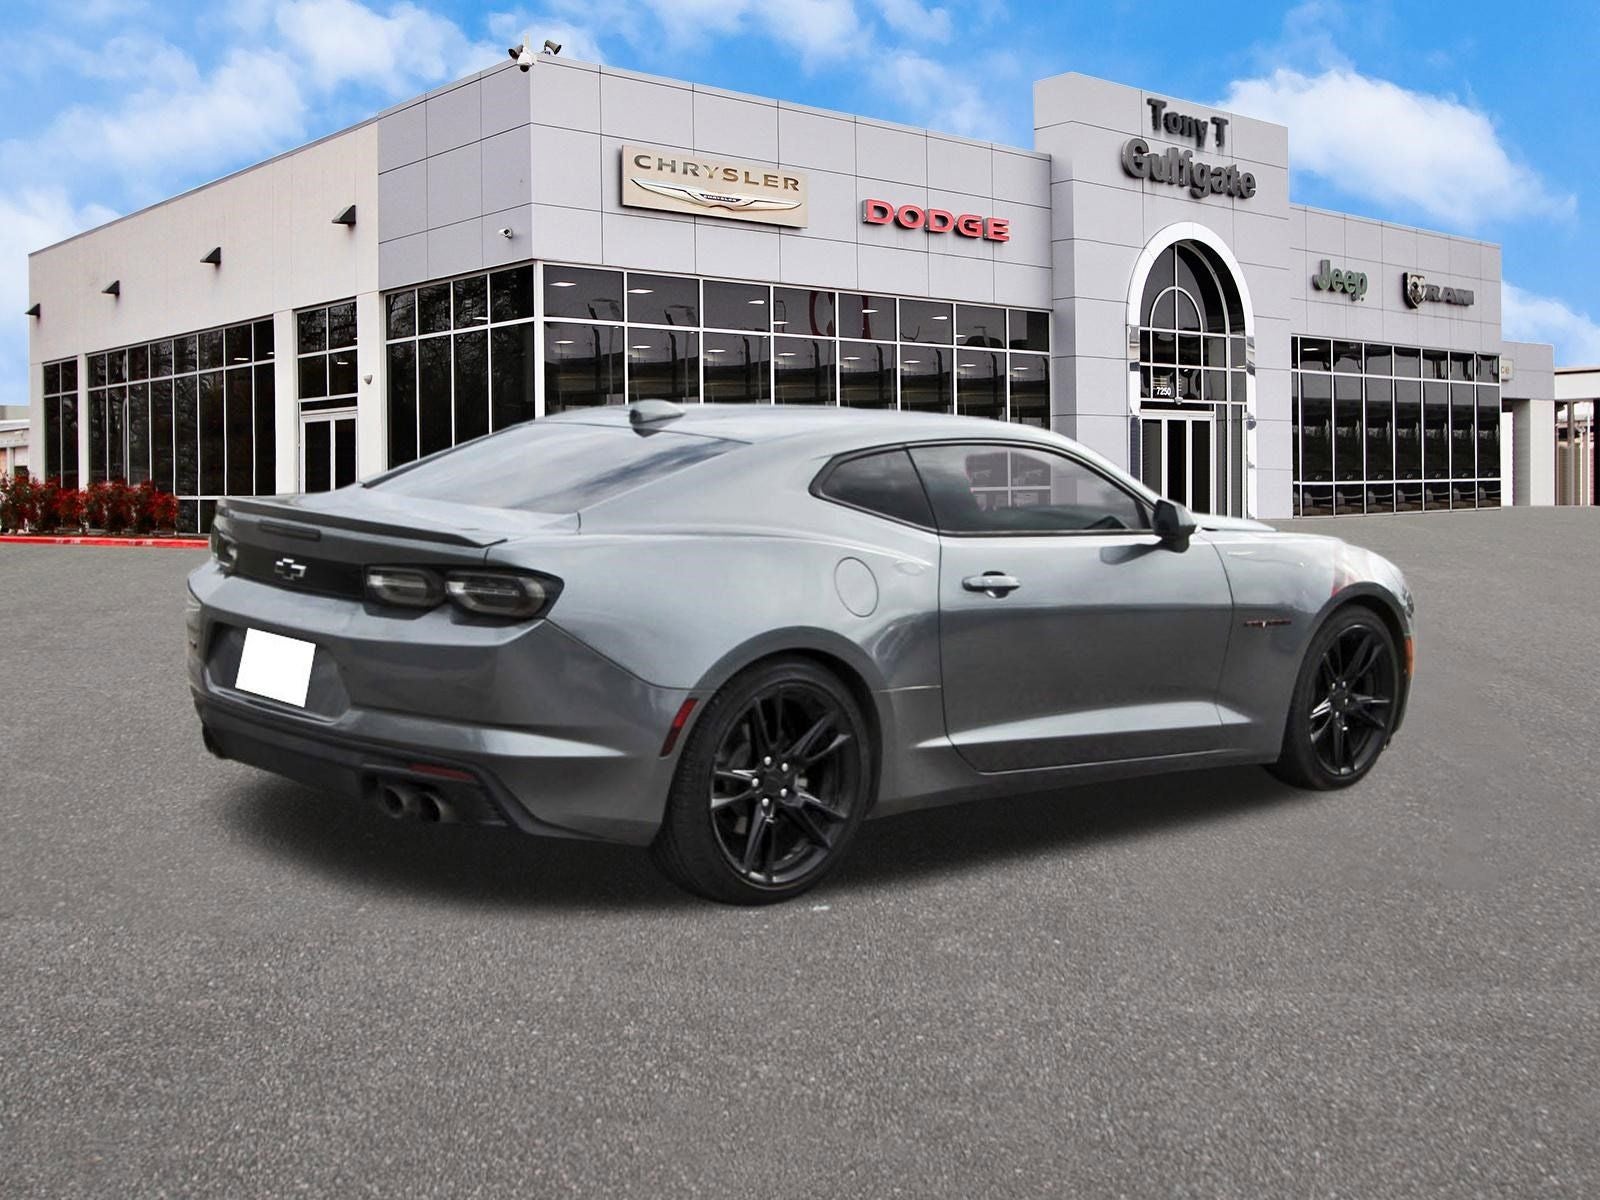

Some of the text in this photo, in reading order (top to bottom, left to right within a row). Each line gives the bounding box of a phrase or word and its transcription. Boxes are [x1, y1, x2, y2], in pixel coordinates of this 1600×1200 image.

[1146, 98, 1229, 147] Tony T
[633, 154, 800, 192] CHRYSLER
[1121, 138, 1257, 199] Gulfgate
[862, 199, 1010, 242] DODGE
[1312, 259, 1368, 301] Jeep
[1425, 284, 1475, 306] RAM
